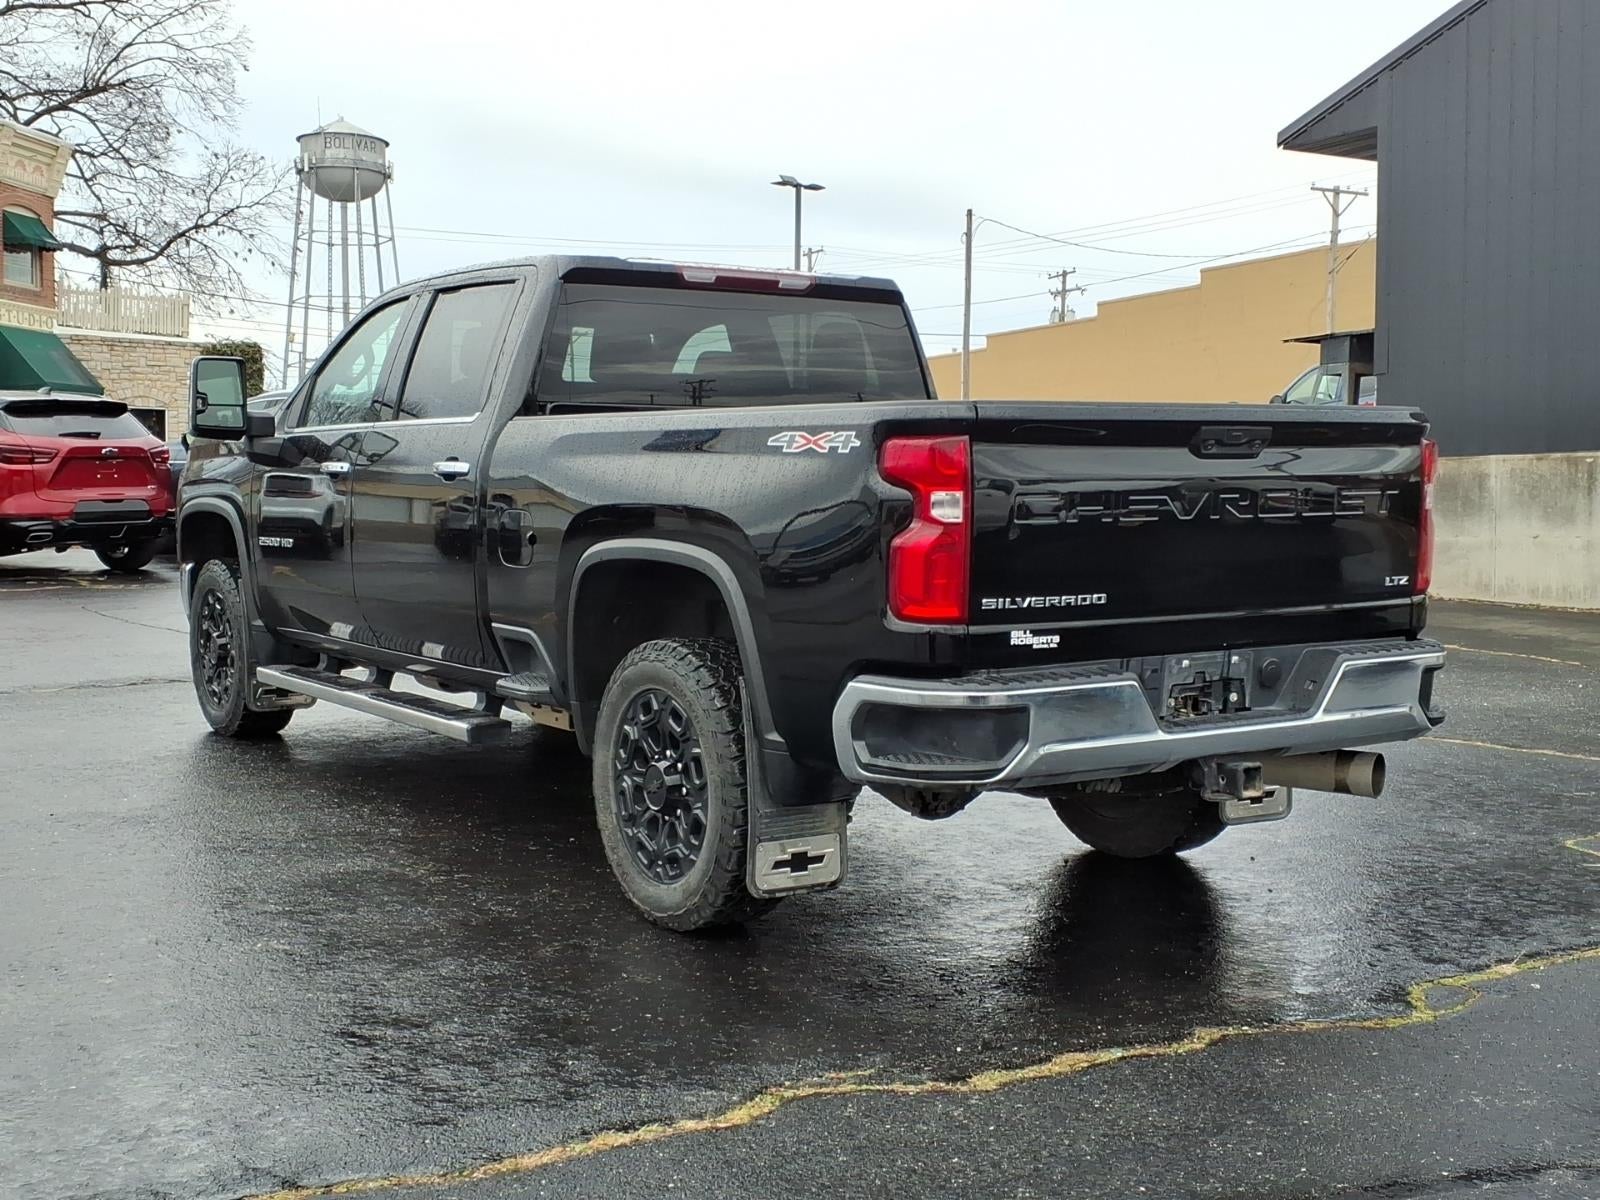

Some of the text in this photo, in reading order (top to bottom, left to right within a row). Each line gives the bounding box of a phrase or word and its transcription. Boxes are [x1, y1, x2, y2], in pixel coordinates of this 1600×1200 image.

[324, 136, 377, 153] BOLIVAR
[1013, 489, 1400, 526] CHEVROLET
[258, 536, 294, 548] 2500 HD
[1384, 575, 1410, 586] LTZ
[981, 593, 1108, 610] SILVERADO
[1010, 629, 1033, 638] BILL
[1010, 634, 1061, 646] ROBERTS
